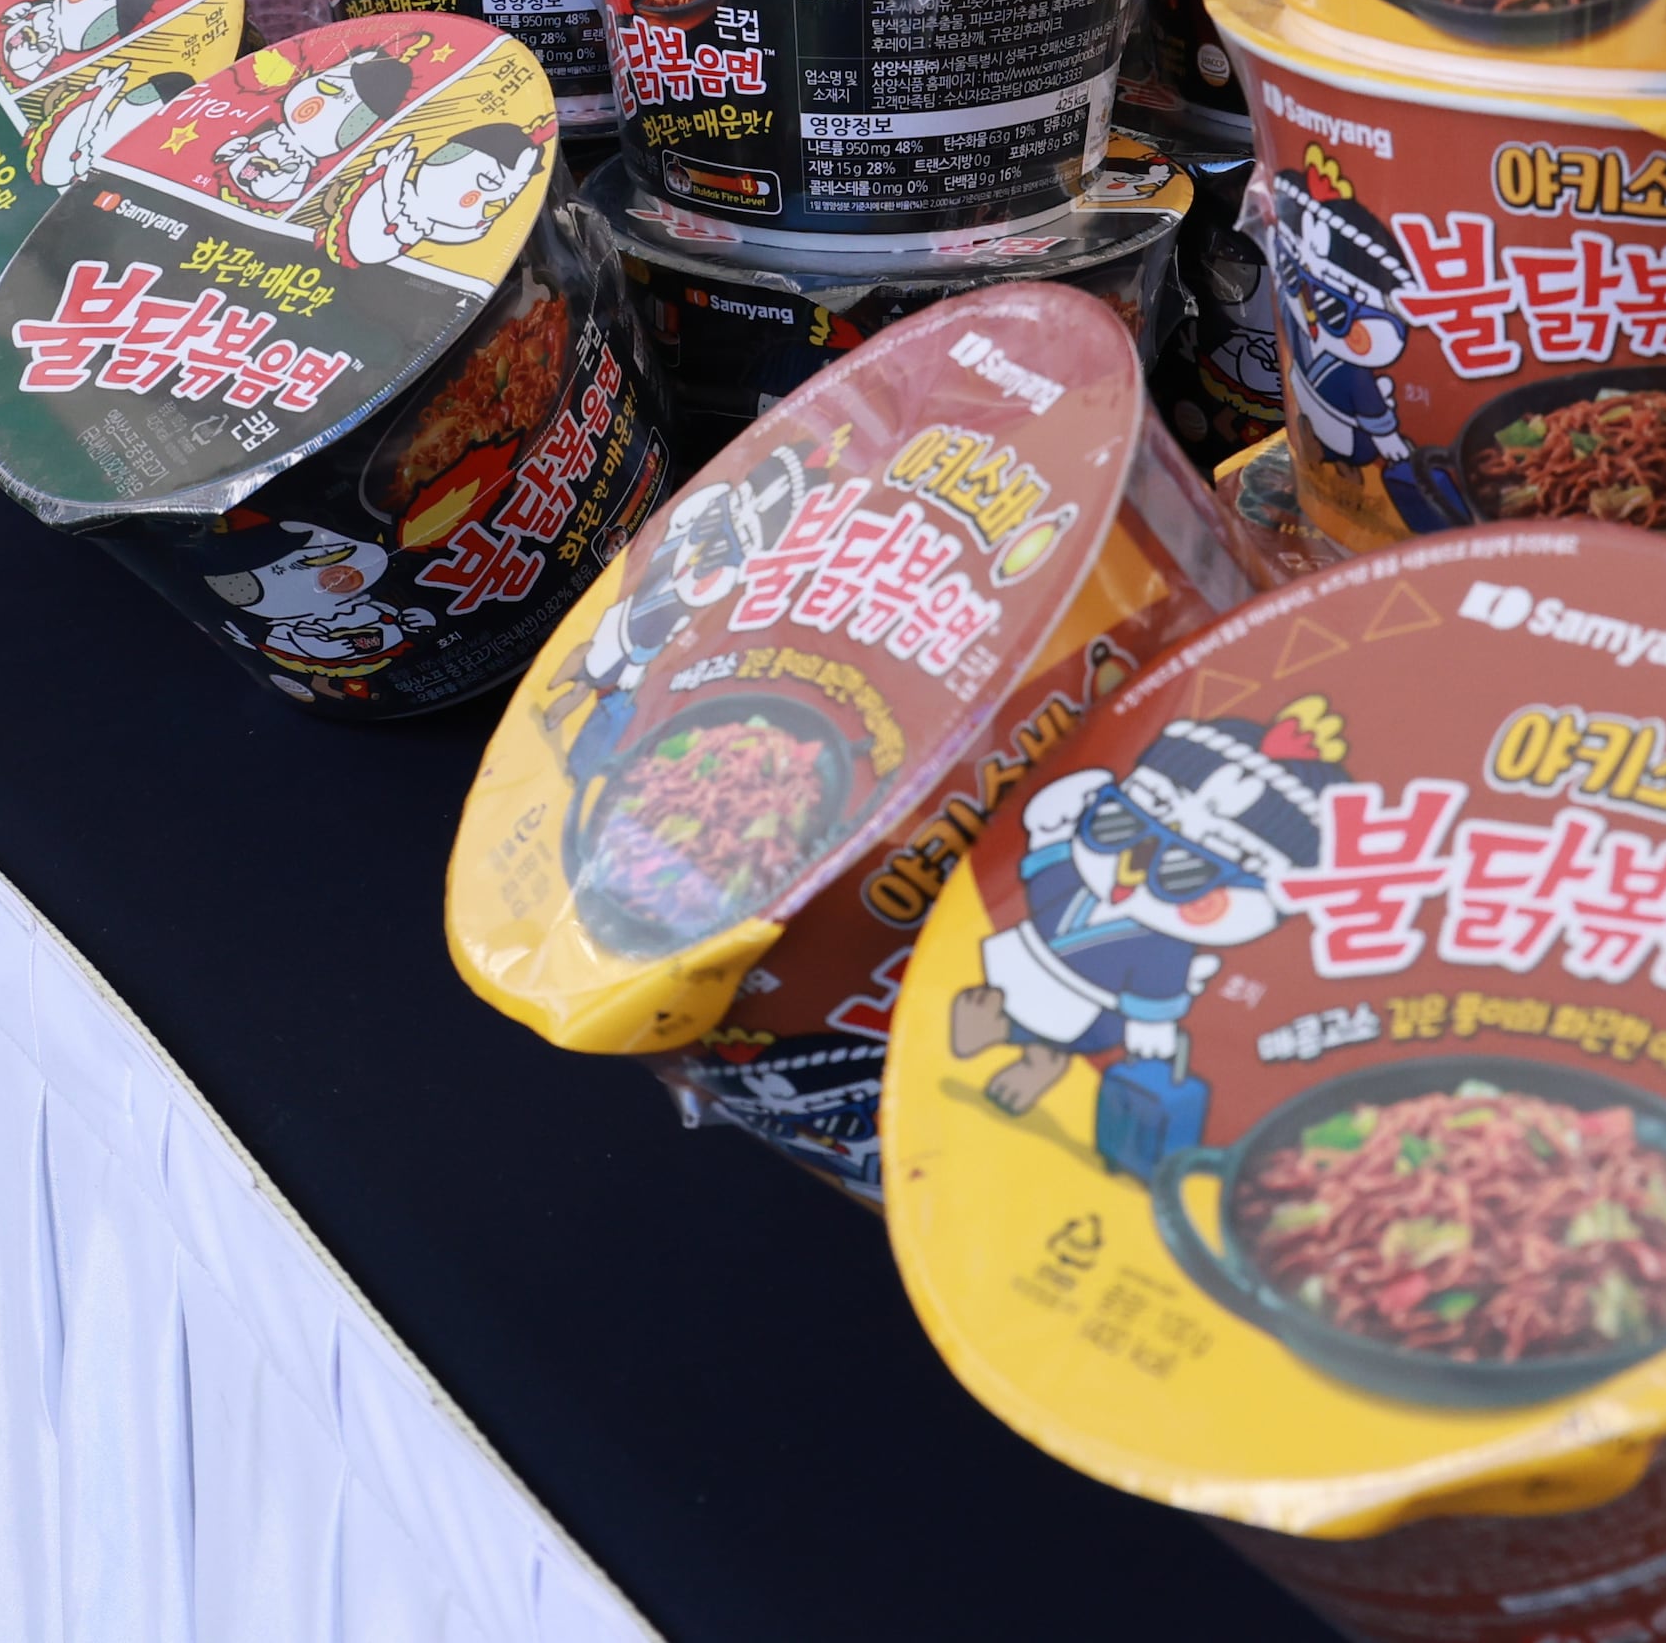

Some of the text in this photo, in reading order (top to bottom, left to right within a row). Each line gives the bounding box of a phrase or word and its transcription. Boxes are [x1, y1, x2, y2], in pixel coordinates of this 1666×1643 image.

[714, 6, 760, 44] 큰컵
[641, 103, 775, 148] 화끈한 매운맛!
[809, 116, 894, 137] 영양정보
[1282, 94, 1395, 161] Samyang
[115, 197, 189, 240] Samyang
[179, 236, 337, 320] 화끈한 매운맛
[709, 290, 795, 325] Samyang
[10, 259, 351, 414] 불닭볶음면
[575, 315, 605, 370] 큰컵
[976, 346, 1069, 416] Samyang
[230, 409, 280, 453] 큰컵
[414, 340, 623, 617] 불닭볶음면
[556, 382, 641, 568] 화끈한 매운맛!
[881, 420, 1052, 548] 야키소바
[728, 476, 1004, 678] 불닭볶음면
